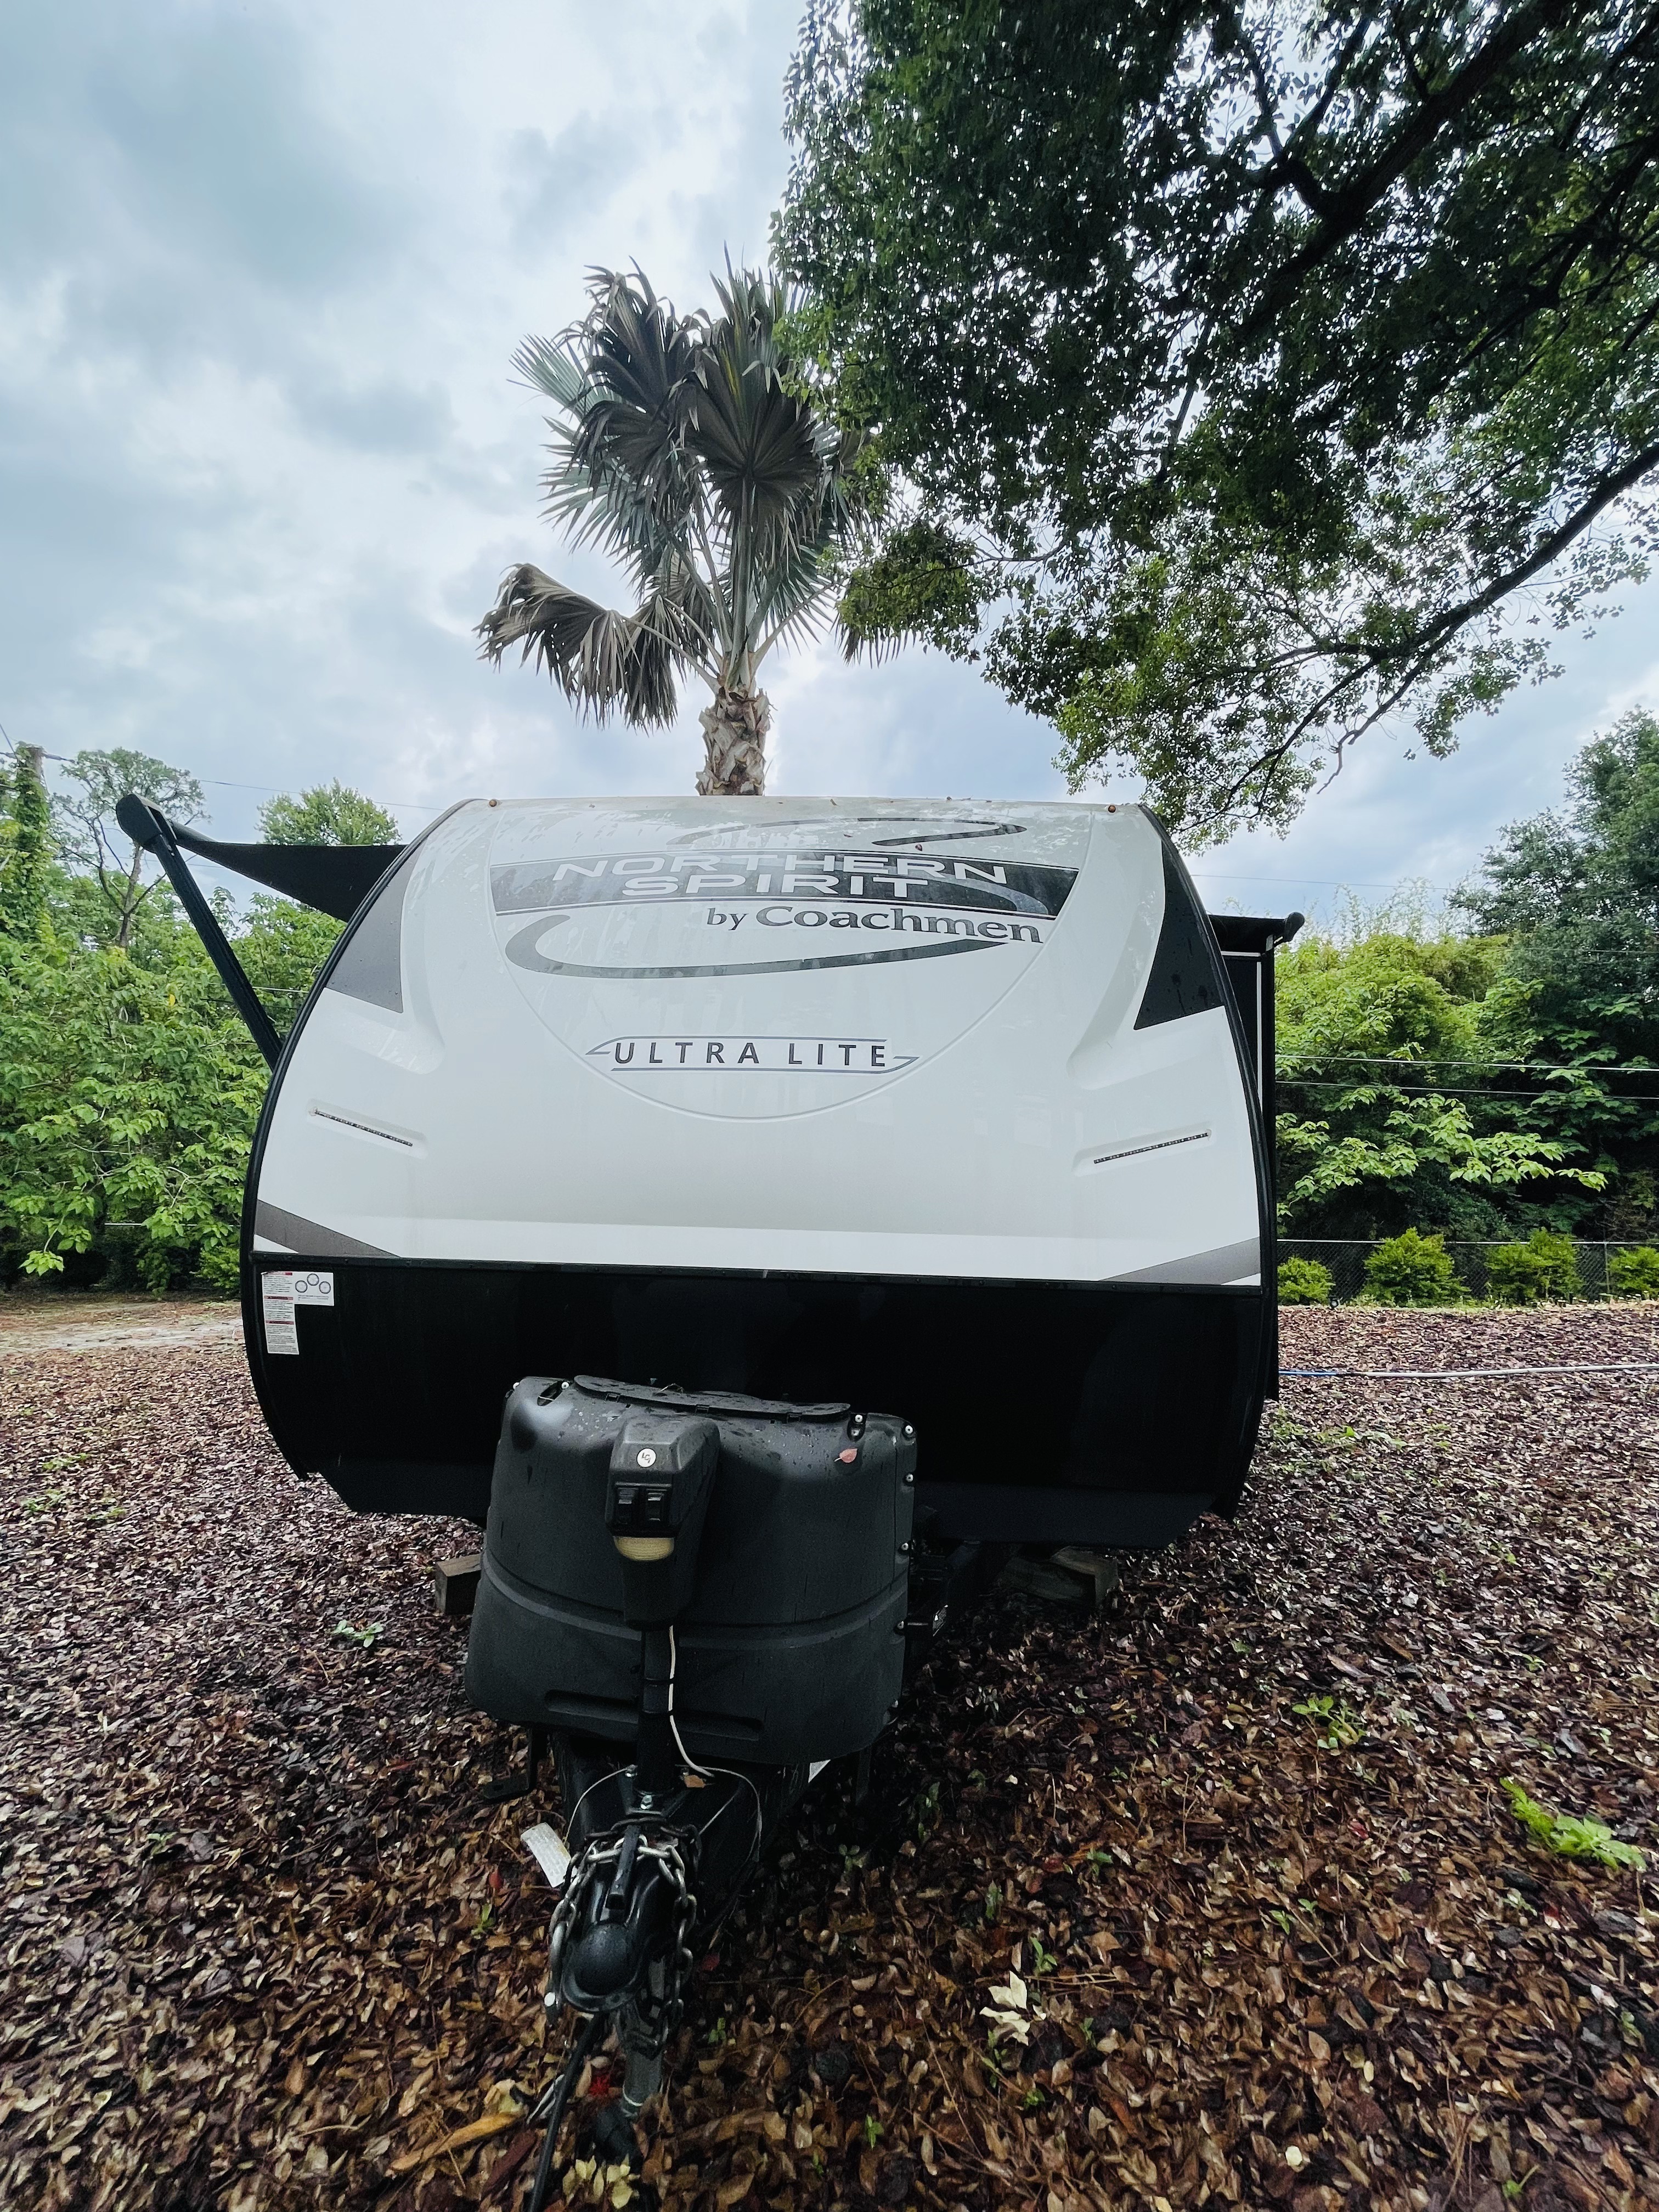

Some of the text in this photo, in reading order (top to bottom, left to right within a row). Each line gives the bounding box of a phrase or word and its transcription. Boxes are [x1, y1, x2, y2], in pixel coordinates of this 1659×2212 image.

[552, 854, 1007, 884] NORTHERN
[622, 873, 928, 898] SPIRIT
[707, 906, 1044, 944] by Coachmen
[614, 1042, 886, 1067] ULTRA LITE
